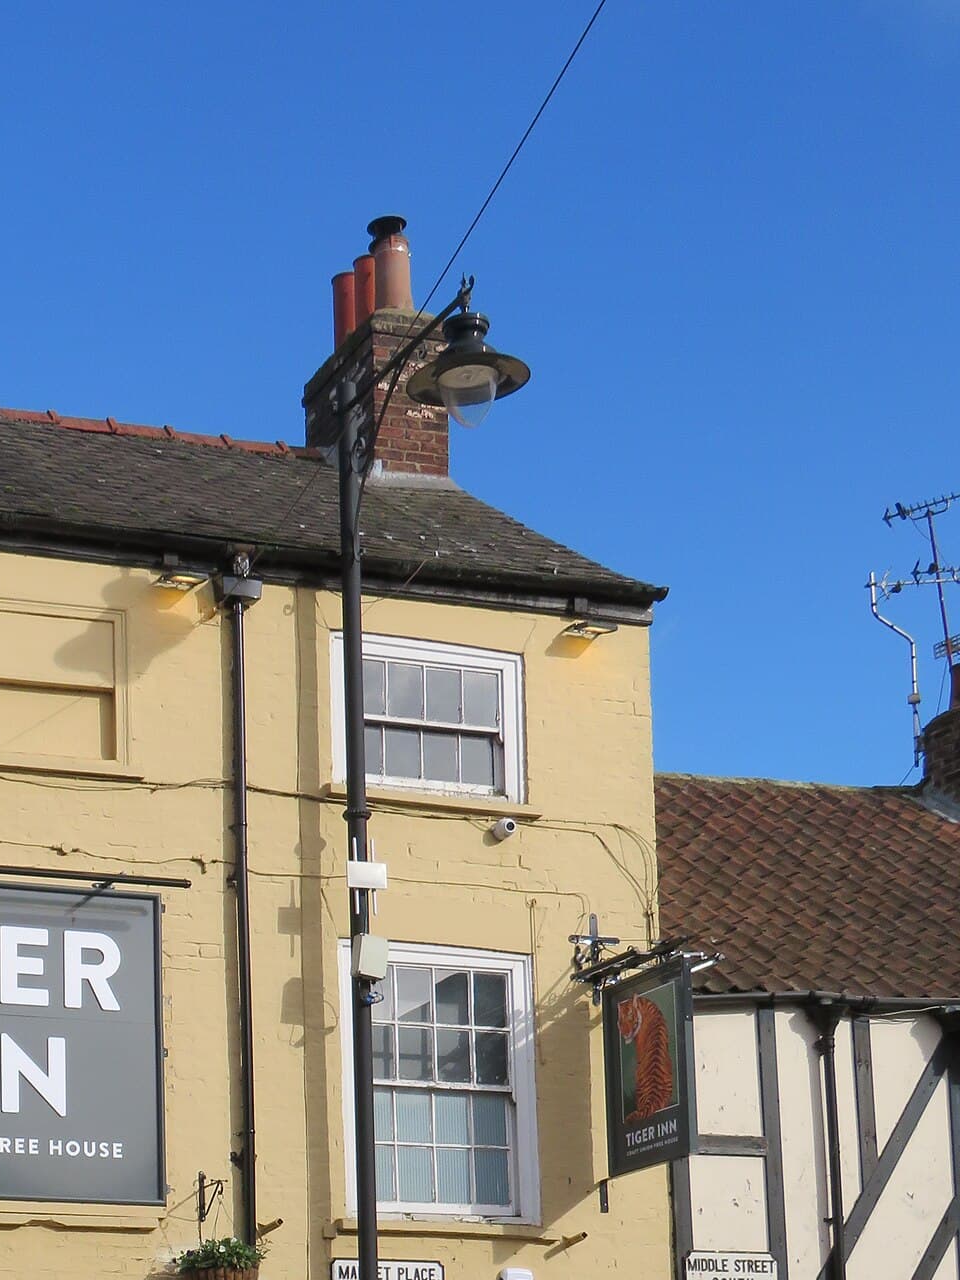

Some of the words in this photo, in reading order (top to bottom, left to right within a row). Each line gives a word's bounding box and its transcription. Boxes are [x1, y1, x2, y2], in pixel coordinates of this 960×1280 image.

[625, 1126, 655, 1147] TIGER
[657, 1118, 677, 1137] INN
[48, 1139, 124, 1159] HOUSE
[338, 1265, 391, 1280] MAET
[687, 1258, 729, 1272] MIDDLE
[734, 1260, 775, 1273] STREET
